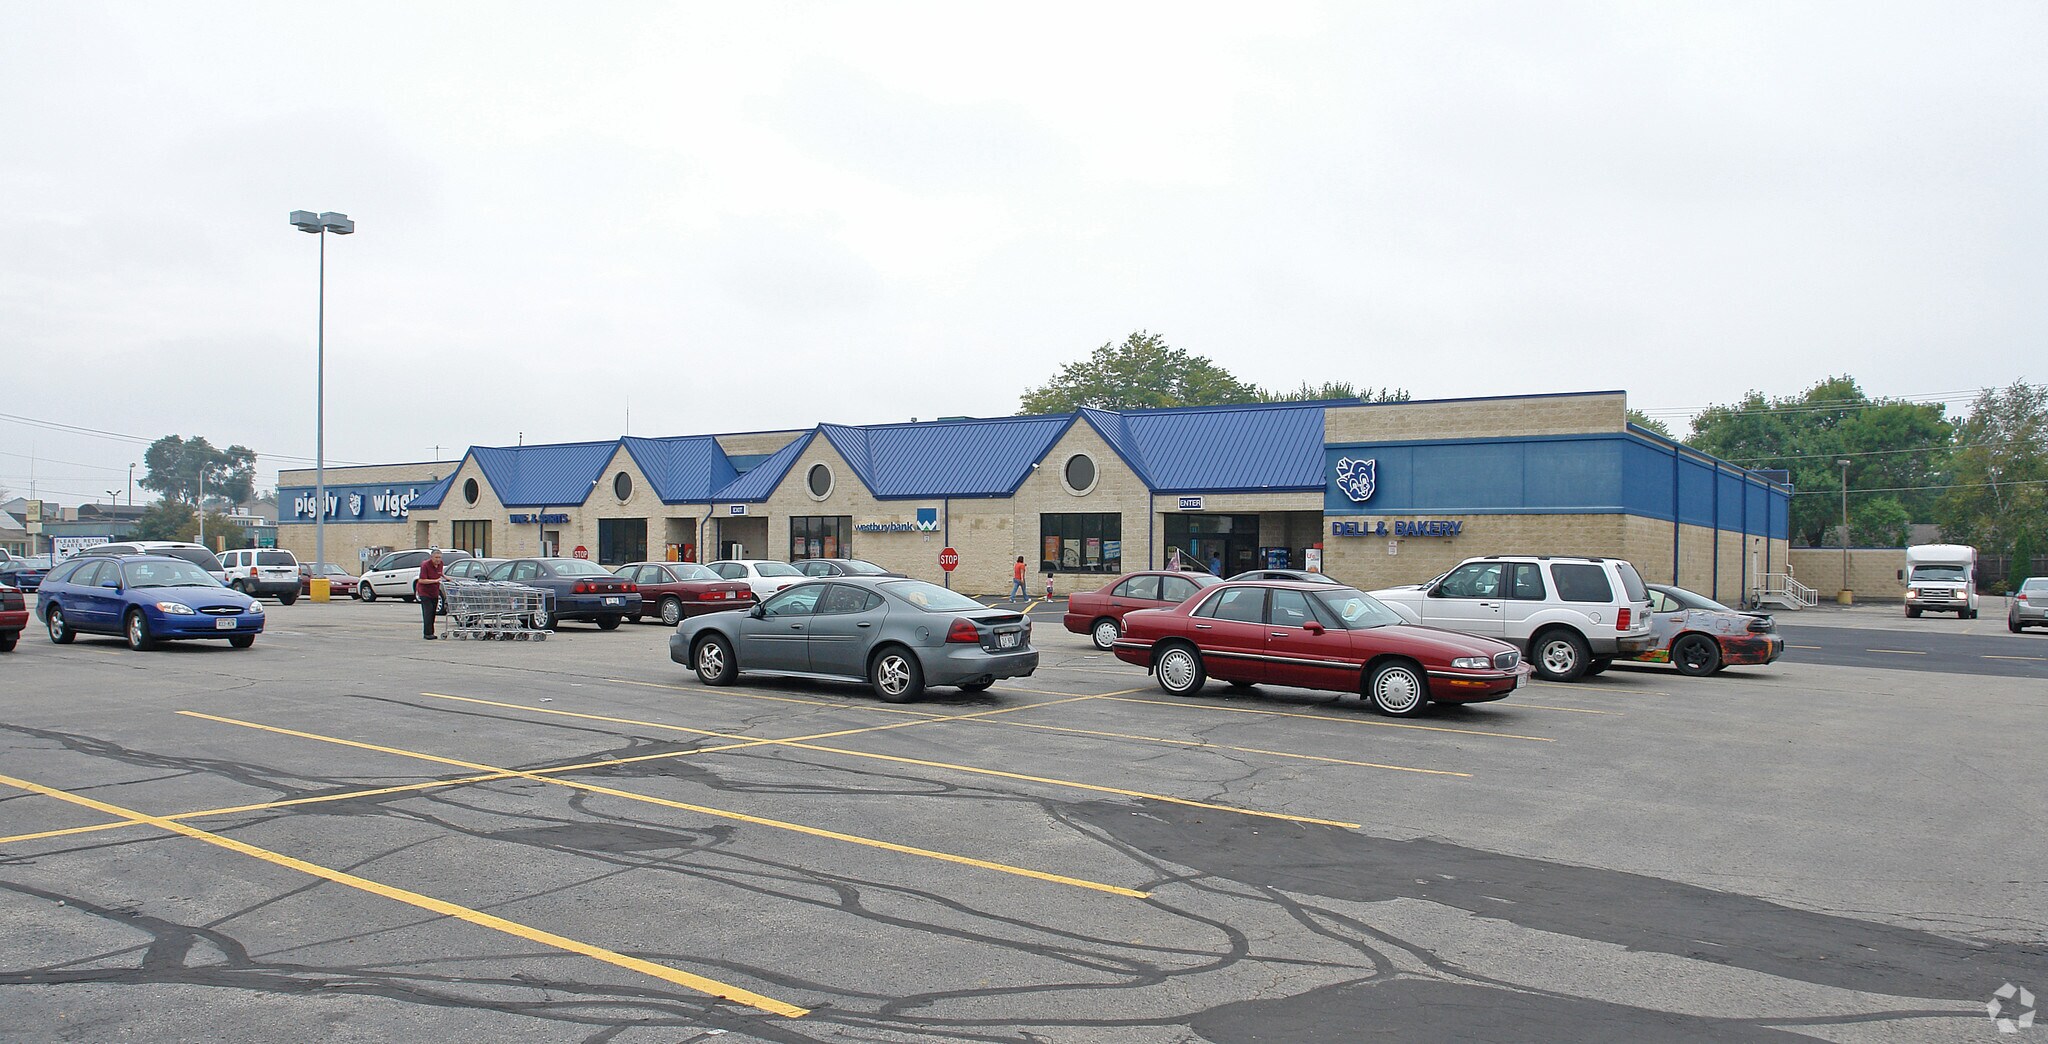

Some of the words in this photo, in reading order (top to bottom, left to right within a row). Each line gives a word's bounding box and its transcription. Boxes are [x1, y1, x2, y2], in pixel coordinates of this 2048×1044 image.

[294, 491, 338, 518] pigly
[1180, 499, 1201, 507] ENTER
[530, 513, 538, 523] &
[539, 513, 569, 524] SPIRITS
[1332, 521, 1369, 537] DELI
[1375, 521, 1388, 537] &
[1395, 520, 1464, 537] BAKERY
[573, 550, 587, 559] STOP
[940, 555, 958, 564] STOP
